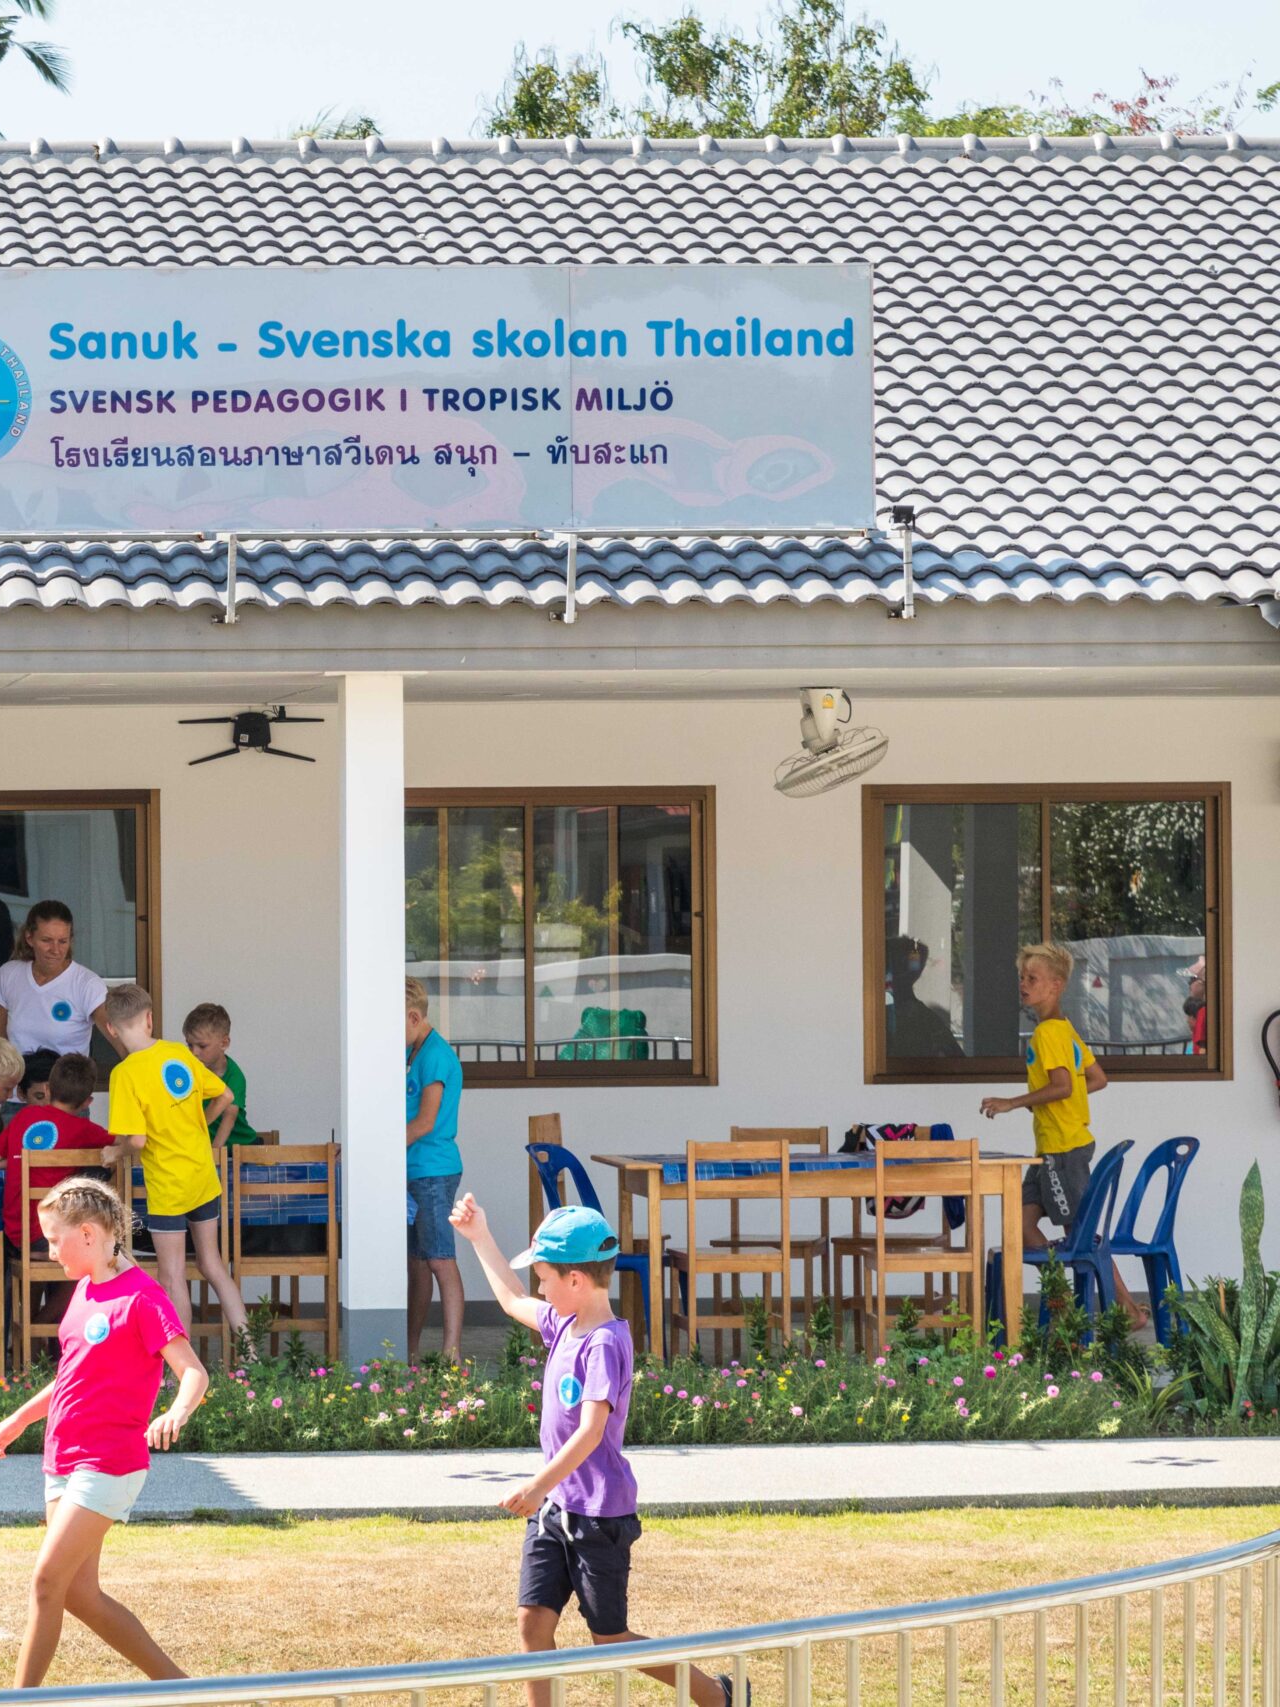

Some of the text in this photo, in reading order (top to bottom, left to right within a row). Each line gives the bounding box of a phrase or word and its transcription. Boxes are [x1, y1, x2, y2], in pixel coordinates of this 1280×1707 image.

[49, 319, 199, 361] Sanuk
[258, 318, 451, 359] Svenska
[472, 318, 627, 358] skolan
[646, 316, 854, 357] Thailand
[0, 346, 29, 437] THAILAND
[50, 380, 674, 415] SVENSK PEDAGOGIK I TROPISK MILJÖ
[50, 435, 421, 468] โรงเรียนสอนภาษาสวีเดน
[433, 442, 498, 478] สนุก
[545, 435, 668, 465] ทับสะแก
[1048, 1170, 1070, 1216] adidas
